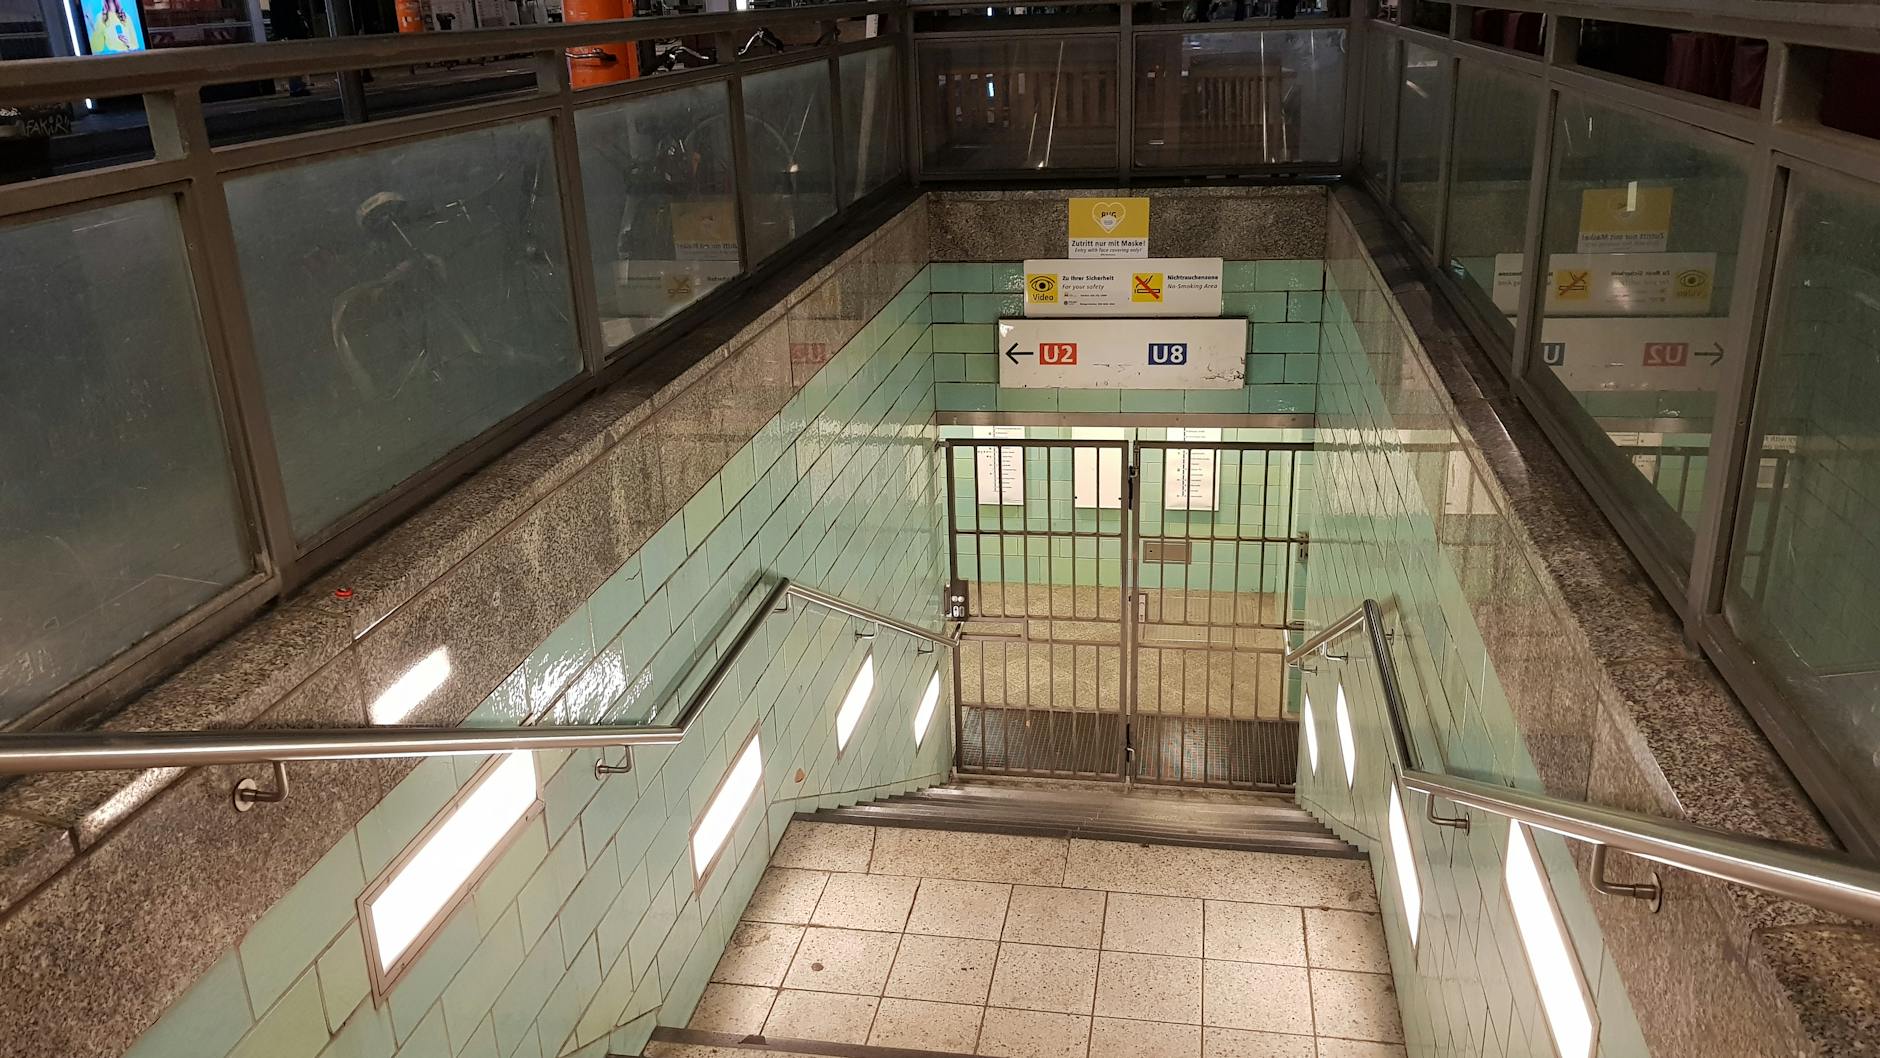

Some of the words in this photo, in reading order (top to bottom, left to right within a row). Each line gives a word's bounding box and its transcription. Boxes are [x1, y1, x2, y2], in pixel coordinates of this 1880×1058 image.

[1032, 293, 1054, 301] Video
[1043, 344, 1073, 363] U2
[1152, 344, 1184, 363] U8
